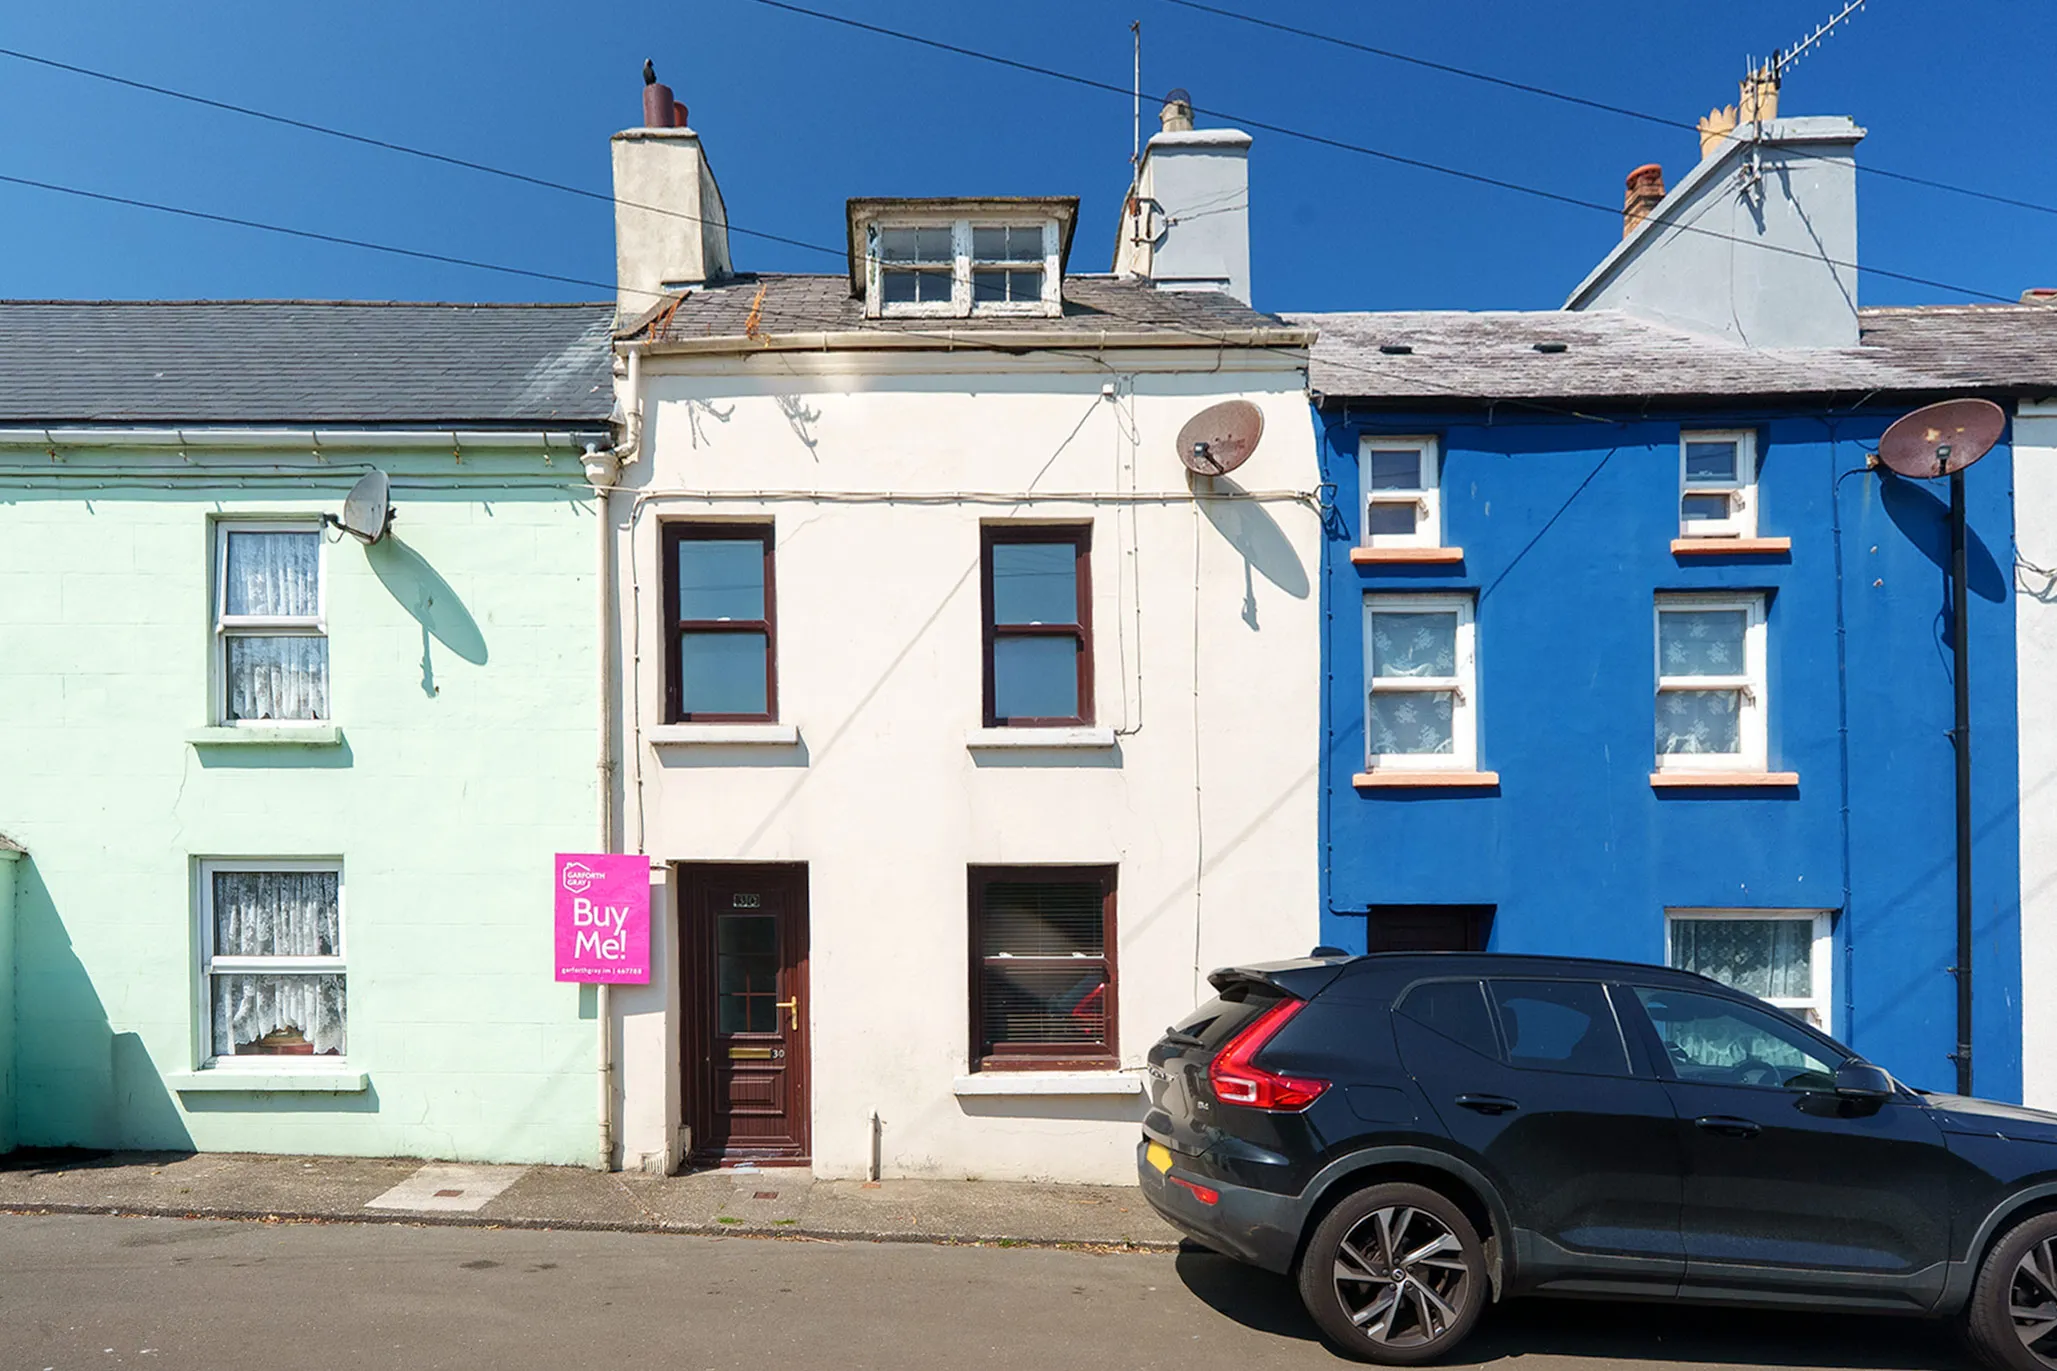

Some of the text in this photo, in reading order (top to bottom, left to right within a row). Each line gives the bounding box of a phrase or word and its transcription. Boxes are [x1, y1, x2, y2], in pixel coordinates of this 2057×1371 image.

[567, 871, 605, 879] GARFORTH
[573, 898, 629, 936] Buy
[574, 931, 627, 960] Me!
[772, 1049, 785, 1059] 30
